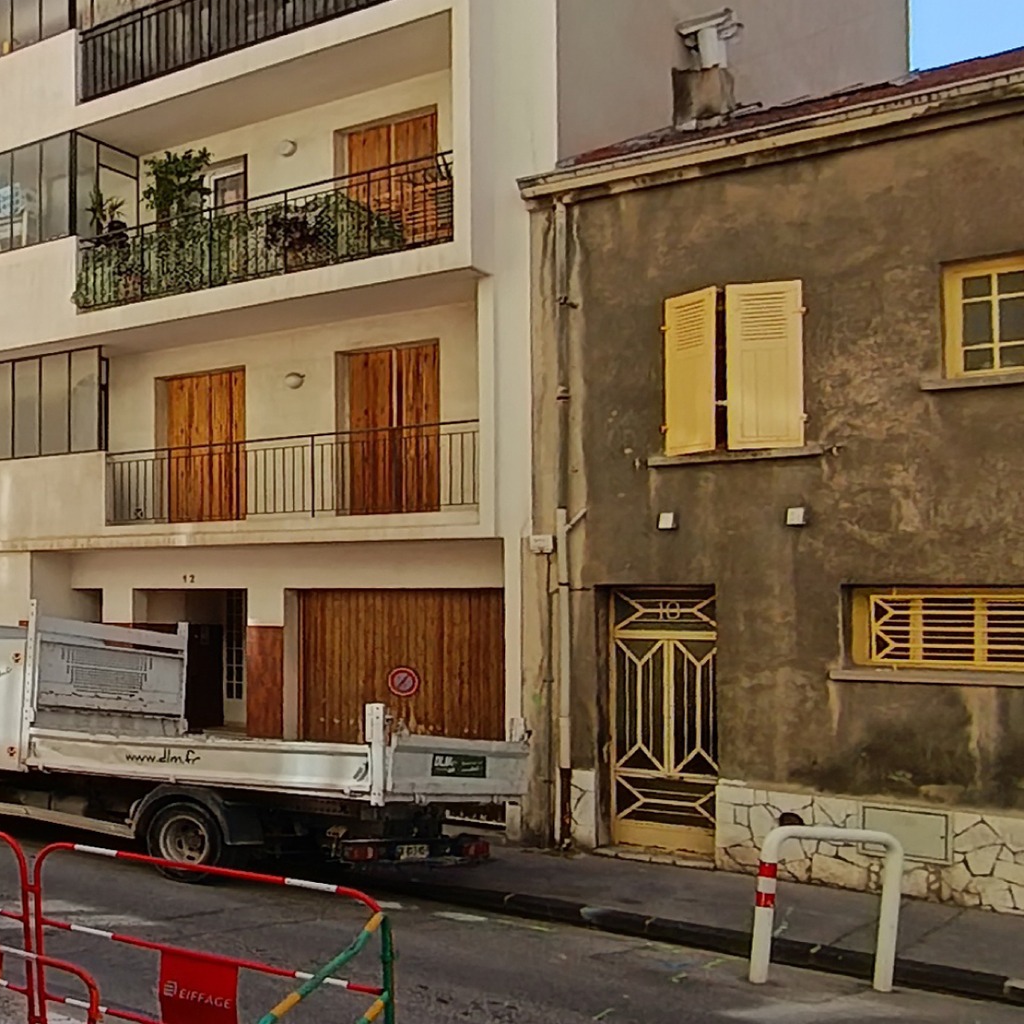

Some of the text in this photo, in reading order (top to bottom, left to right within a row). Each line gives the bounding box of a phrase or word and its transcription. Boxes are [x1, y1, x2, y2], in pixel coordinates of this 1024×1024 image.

[182, 573, 196, 584] 12
[658, 600, 681, 621] 10
[178, 988, 233, 1010] EIFFAGE
